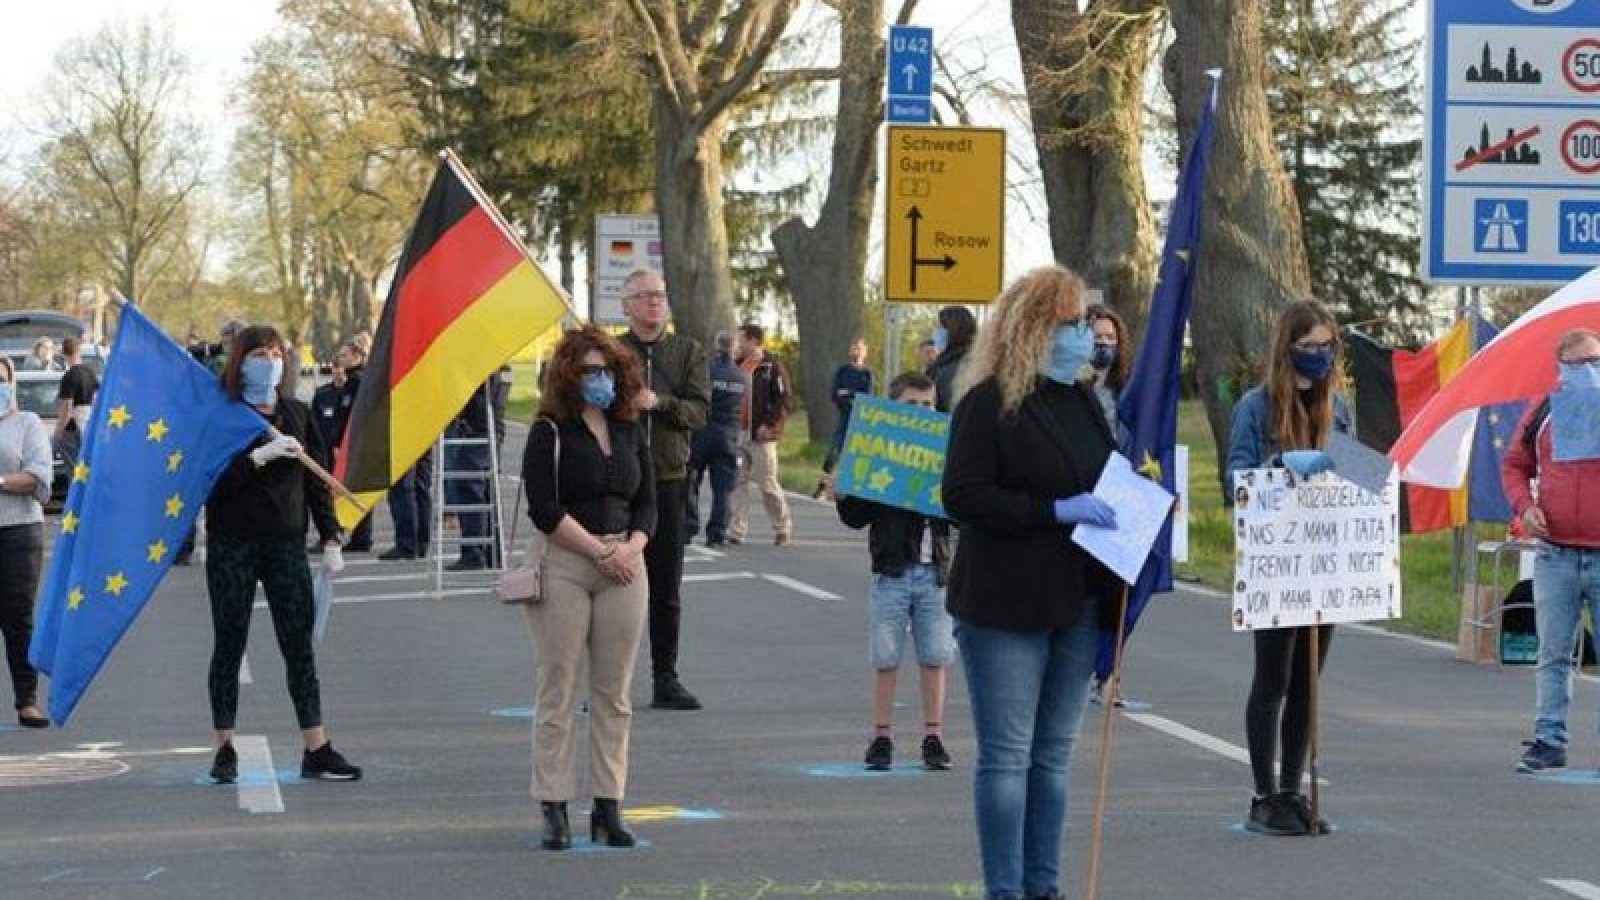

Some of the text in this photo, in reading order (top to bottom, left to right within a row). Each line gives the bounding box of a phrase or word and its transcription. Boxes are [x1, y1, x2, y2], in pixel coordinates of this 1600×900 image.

[1575, 54, 1600, 78] 50
[901, 134, 973, 153] Schwedt
[1573, 133, 1600, 159] 100
[899, 156, 945, 173] Gartz
[1565, 210, 1600, 243] 130
[934, 231, 991, 249] Rosow
[1257, 487, 1285, 511] NIE
[1311, 552, 1338, 575] UNS
[1348, 551, 1385, 573] NICHT
[1247, 589, 1271, 614] VON
